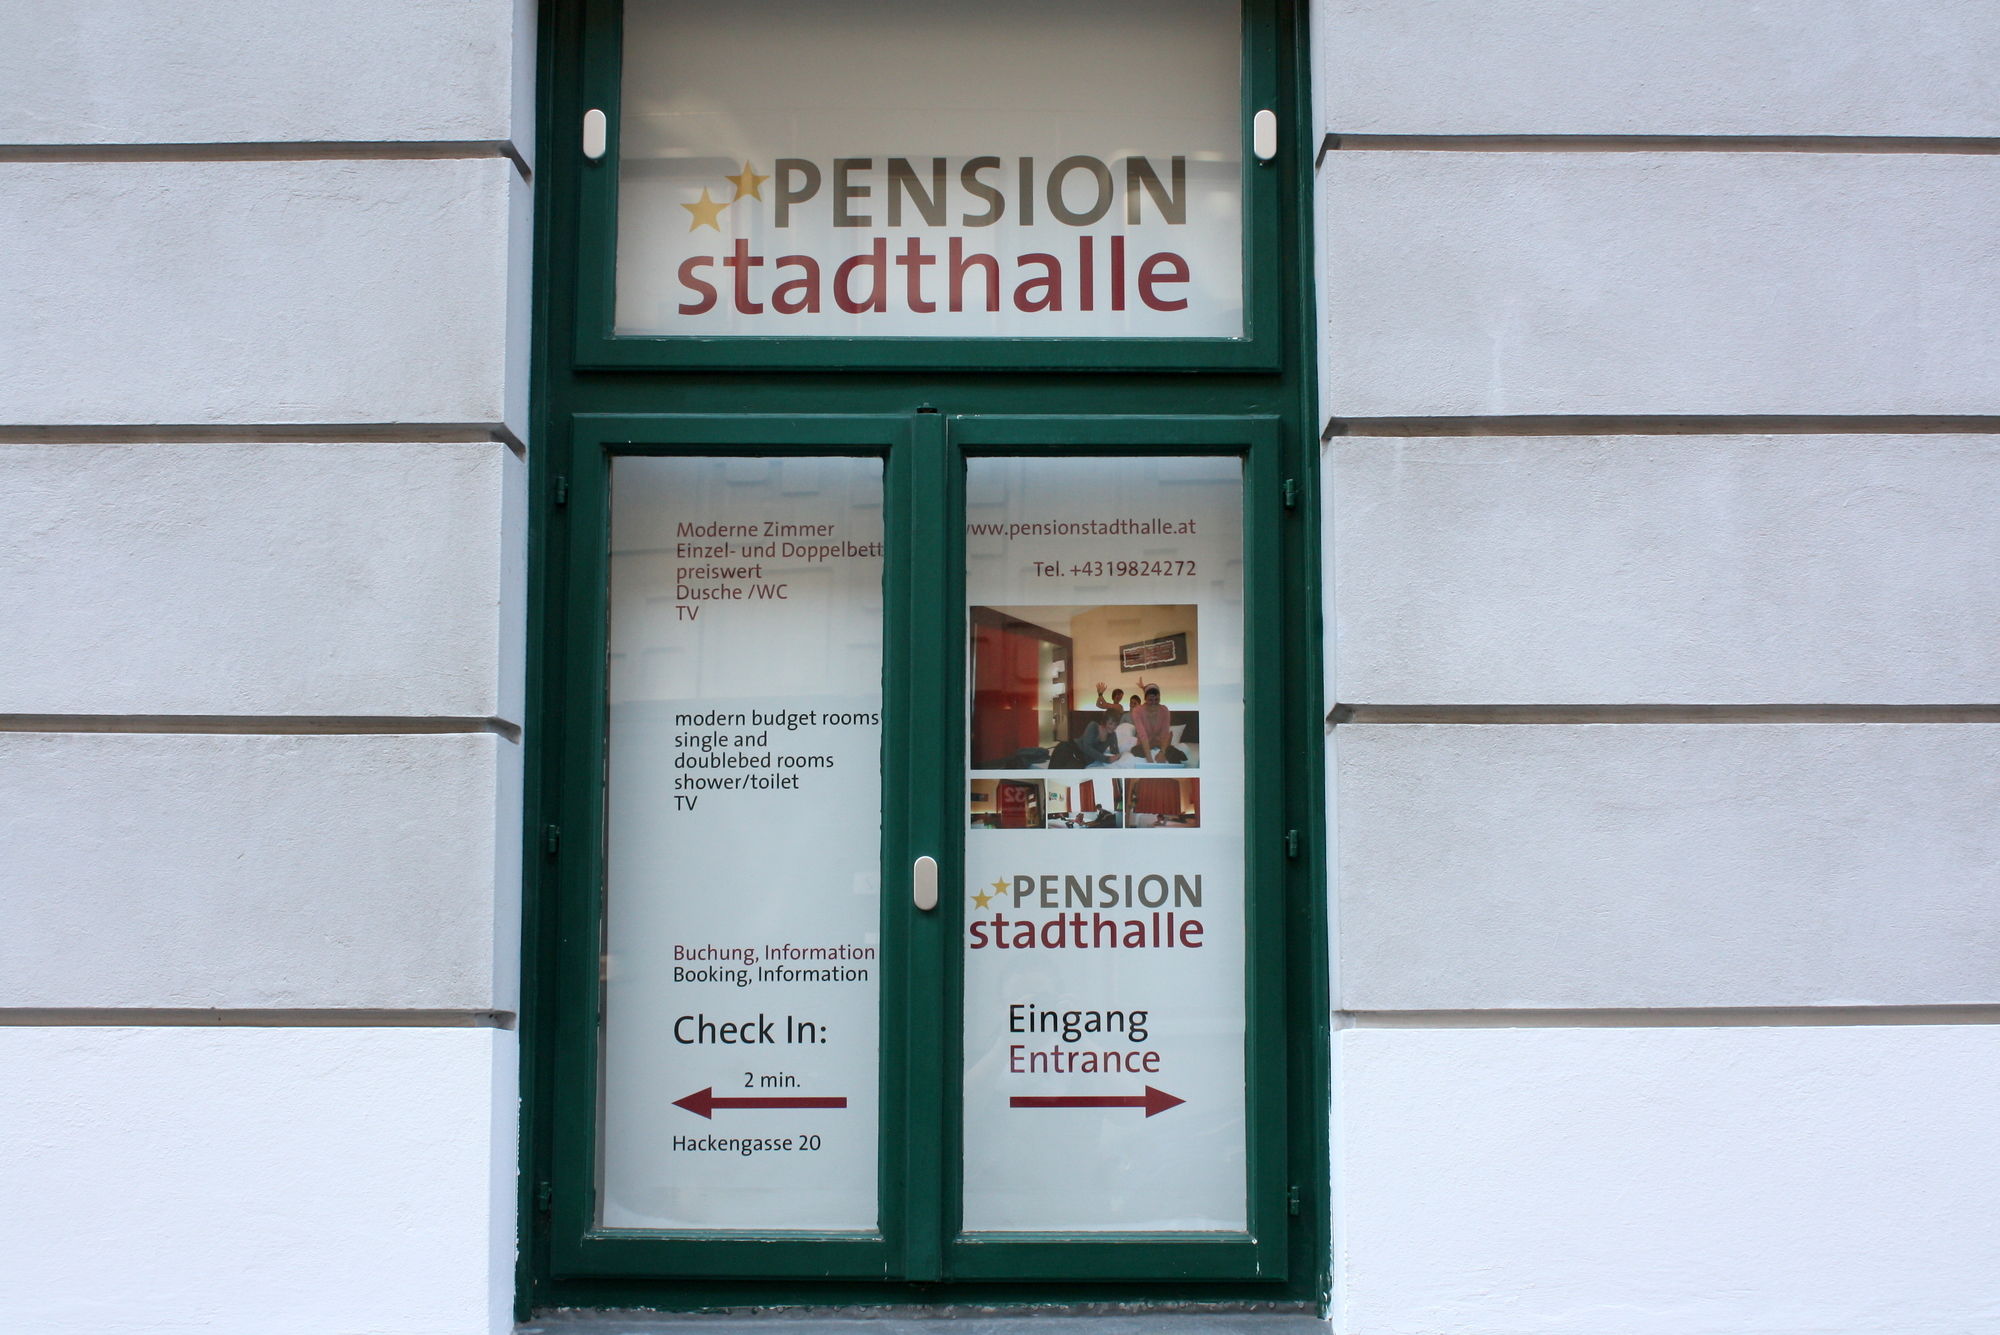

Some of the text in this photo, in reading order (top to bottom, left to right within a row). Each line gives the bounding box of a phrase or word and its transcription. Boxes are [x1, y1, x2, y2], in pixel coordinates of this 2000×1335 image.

[775, 155, 1187, 228] PENSION
[678, 235, 1190, 315] stadthalle
[677, 521, 834, 537] Moderne Zimmer
[967, 518, 1196, 540] ww.pensionstadthalle.at
[677, 543, 735, 558] Einzel-
[742, 542, 775, 558] und
[677, 564, 762, 585] preiswert
[1034, 561, 1196, 576] Tel. +4319824272
[677, 584, 787, 600] Dusche /WC
[676, 606, 699, 620] TV
[676, 709, 878, 730] modern budget rooms
[675, 731, 767, 752] single and
[675, 751, 833, 768] doublebed rooms
[675, 773, 799, 789] shower/toilet
[674, 796, 697, 811] TV
[1014, 874, 1202, 908] PENSION
[970, 912, 1203, 949] stadthalle
[674, 944, 874, 966] Buchung, Information
[674, 965, 867, 987] Booking, Information
[674, 1014, 826, 1044] Check In:
[1010, 1004, 1148, 1043] Eingang
[1010, 1045, 1160, 1073] Entrance
[745, 1072, 800, 1087] 2 min.
[674, 1135, 820, 1156] Hackengasse 20
